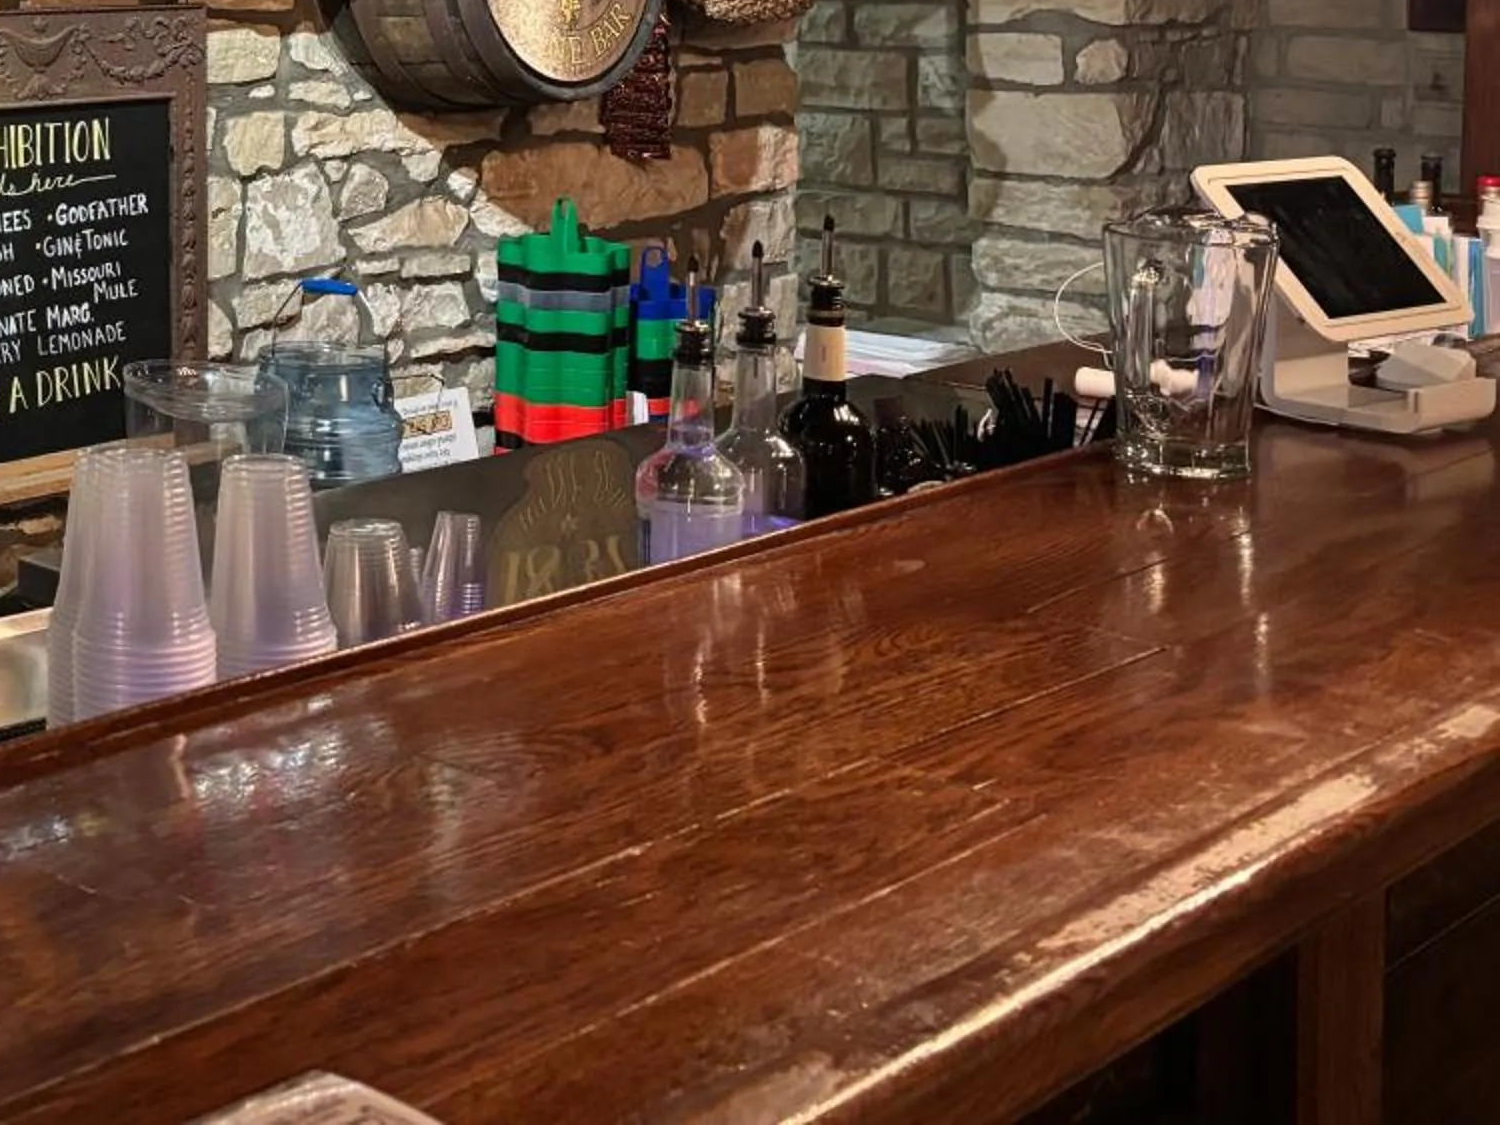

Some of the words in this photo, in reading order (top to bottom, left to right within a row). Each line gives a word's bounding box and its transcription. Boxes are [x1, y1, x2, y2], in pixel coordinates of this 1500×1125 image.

[589, 2, 633, 58] BAR
[25, 172, 77, 194] here
[55, 193, 149, 225] GODFATHER
[51, 260, 122, 291] MISSOURI
[93, 278, 139, 304] MULE
[46, 301, 95, 330] MARG.
[37, 321, 127, 356] LEMONADE
[9, 376, 29, 414] A
[36, 355, 122, 408] DRINK
